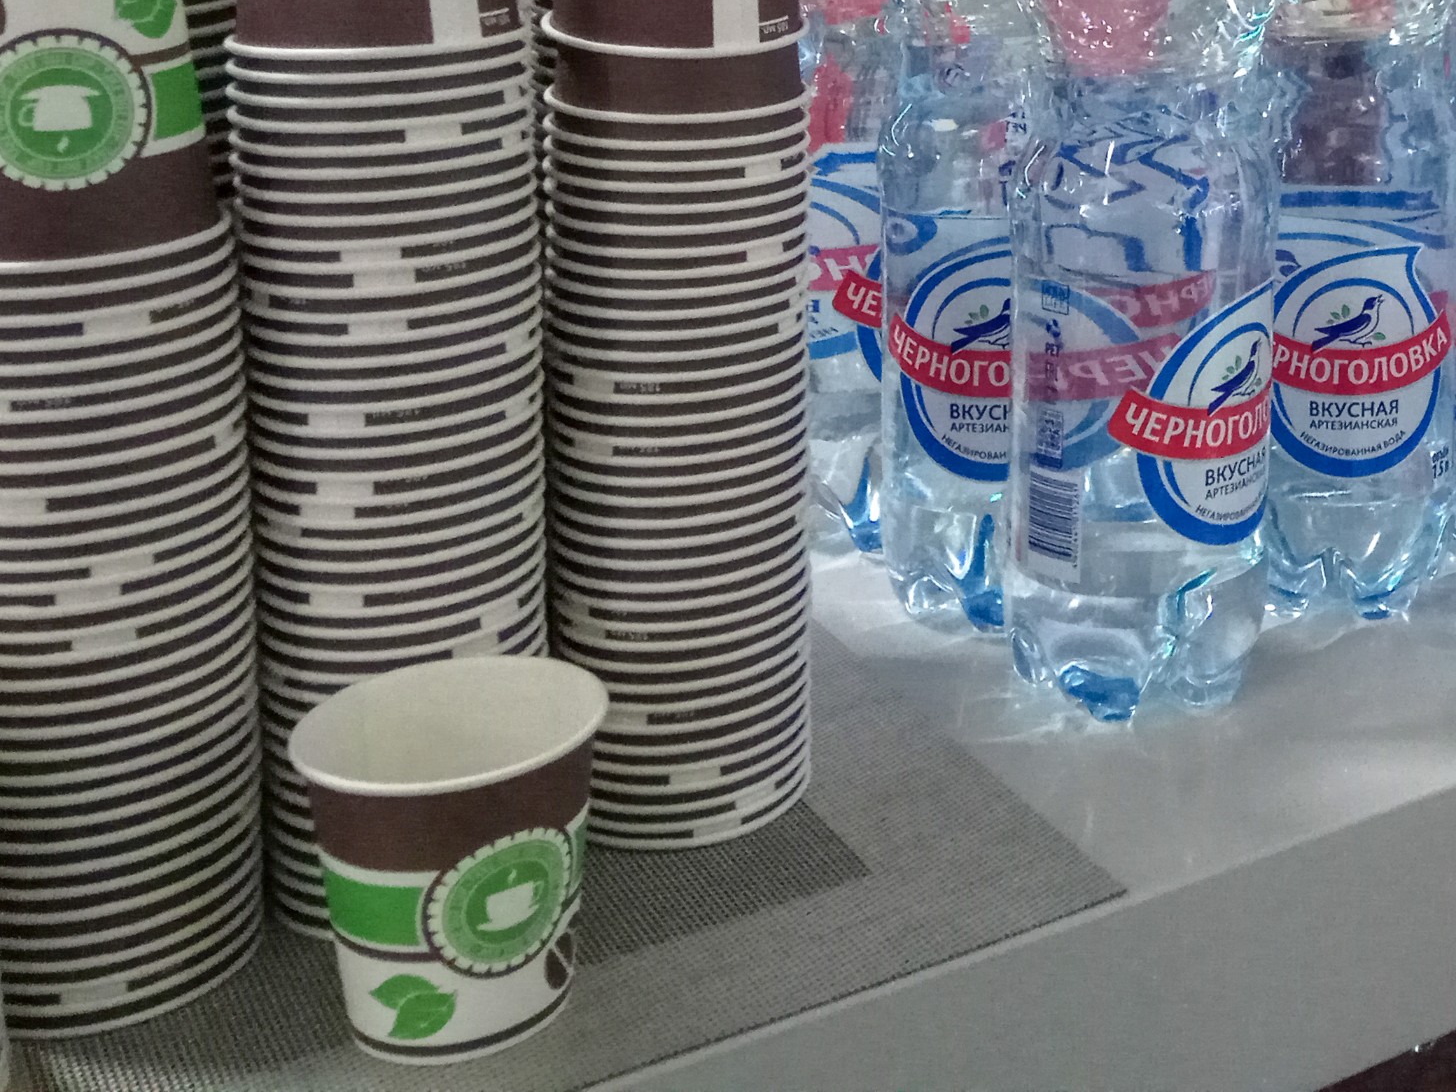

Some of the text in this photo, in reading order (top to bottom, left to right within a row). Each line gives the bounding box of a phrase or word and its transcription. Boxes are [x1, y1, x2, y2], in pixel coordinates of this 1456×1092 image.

[894, 325, 1010, 387] ЧЕРНОГО
[1309, 398, 1399, 418] ВКУСНАЯ
[1309, 417, 1399, 432] АРТЕЗИАНСКАЯ
[1300, 430, 1407, 458] НЕГАЗИРОВАННАЯ ВОДА
